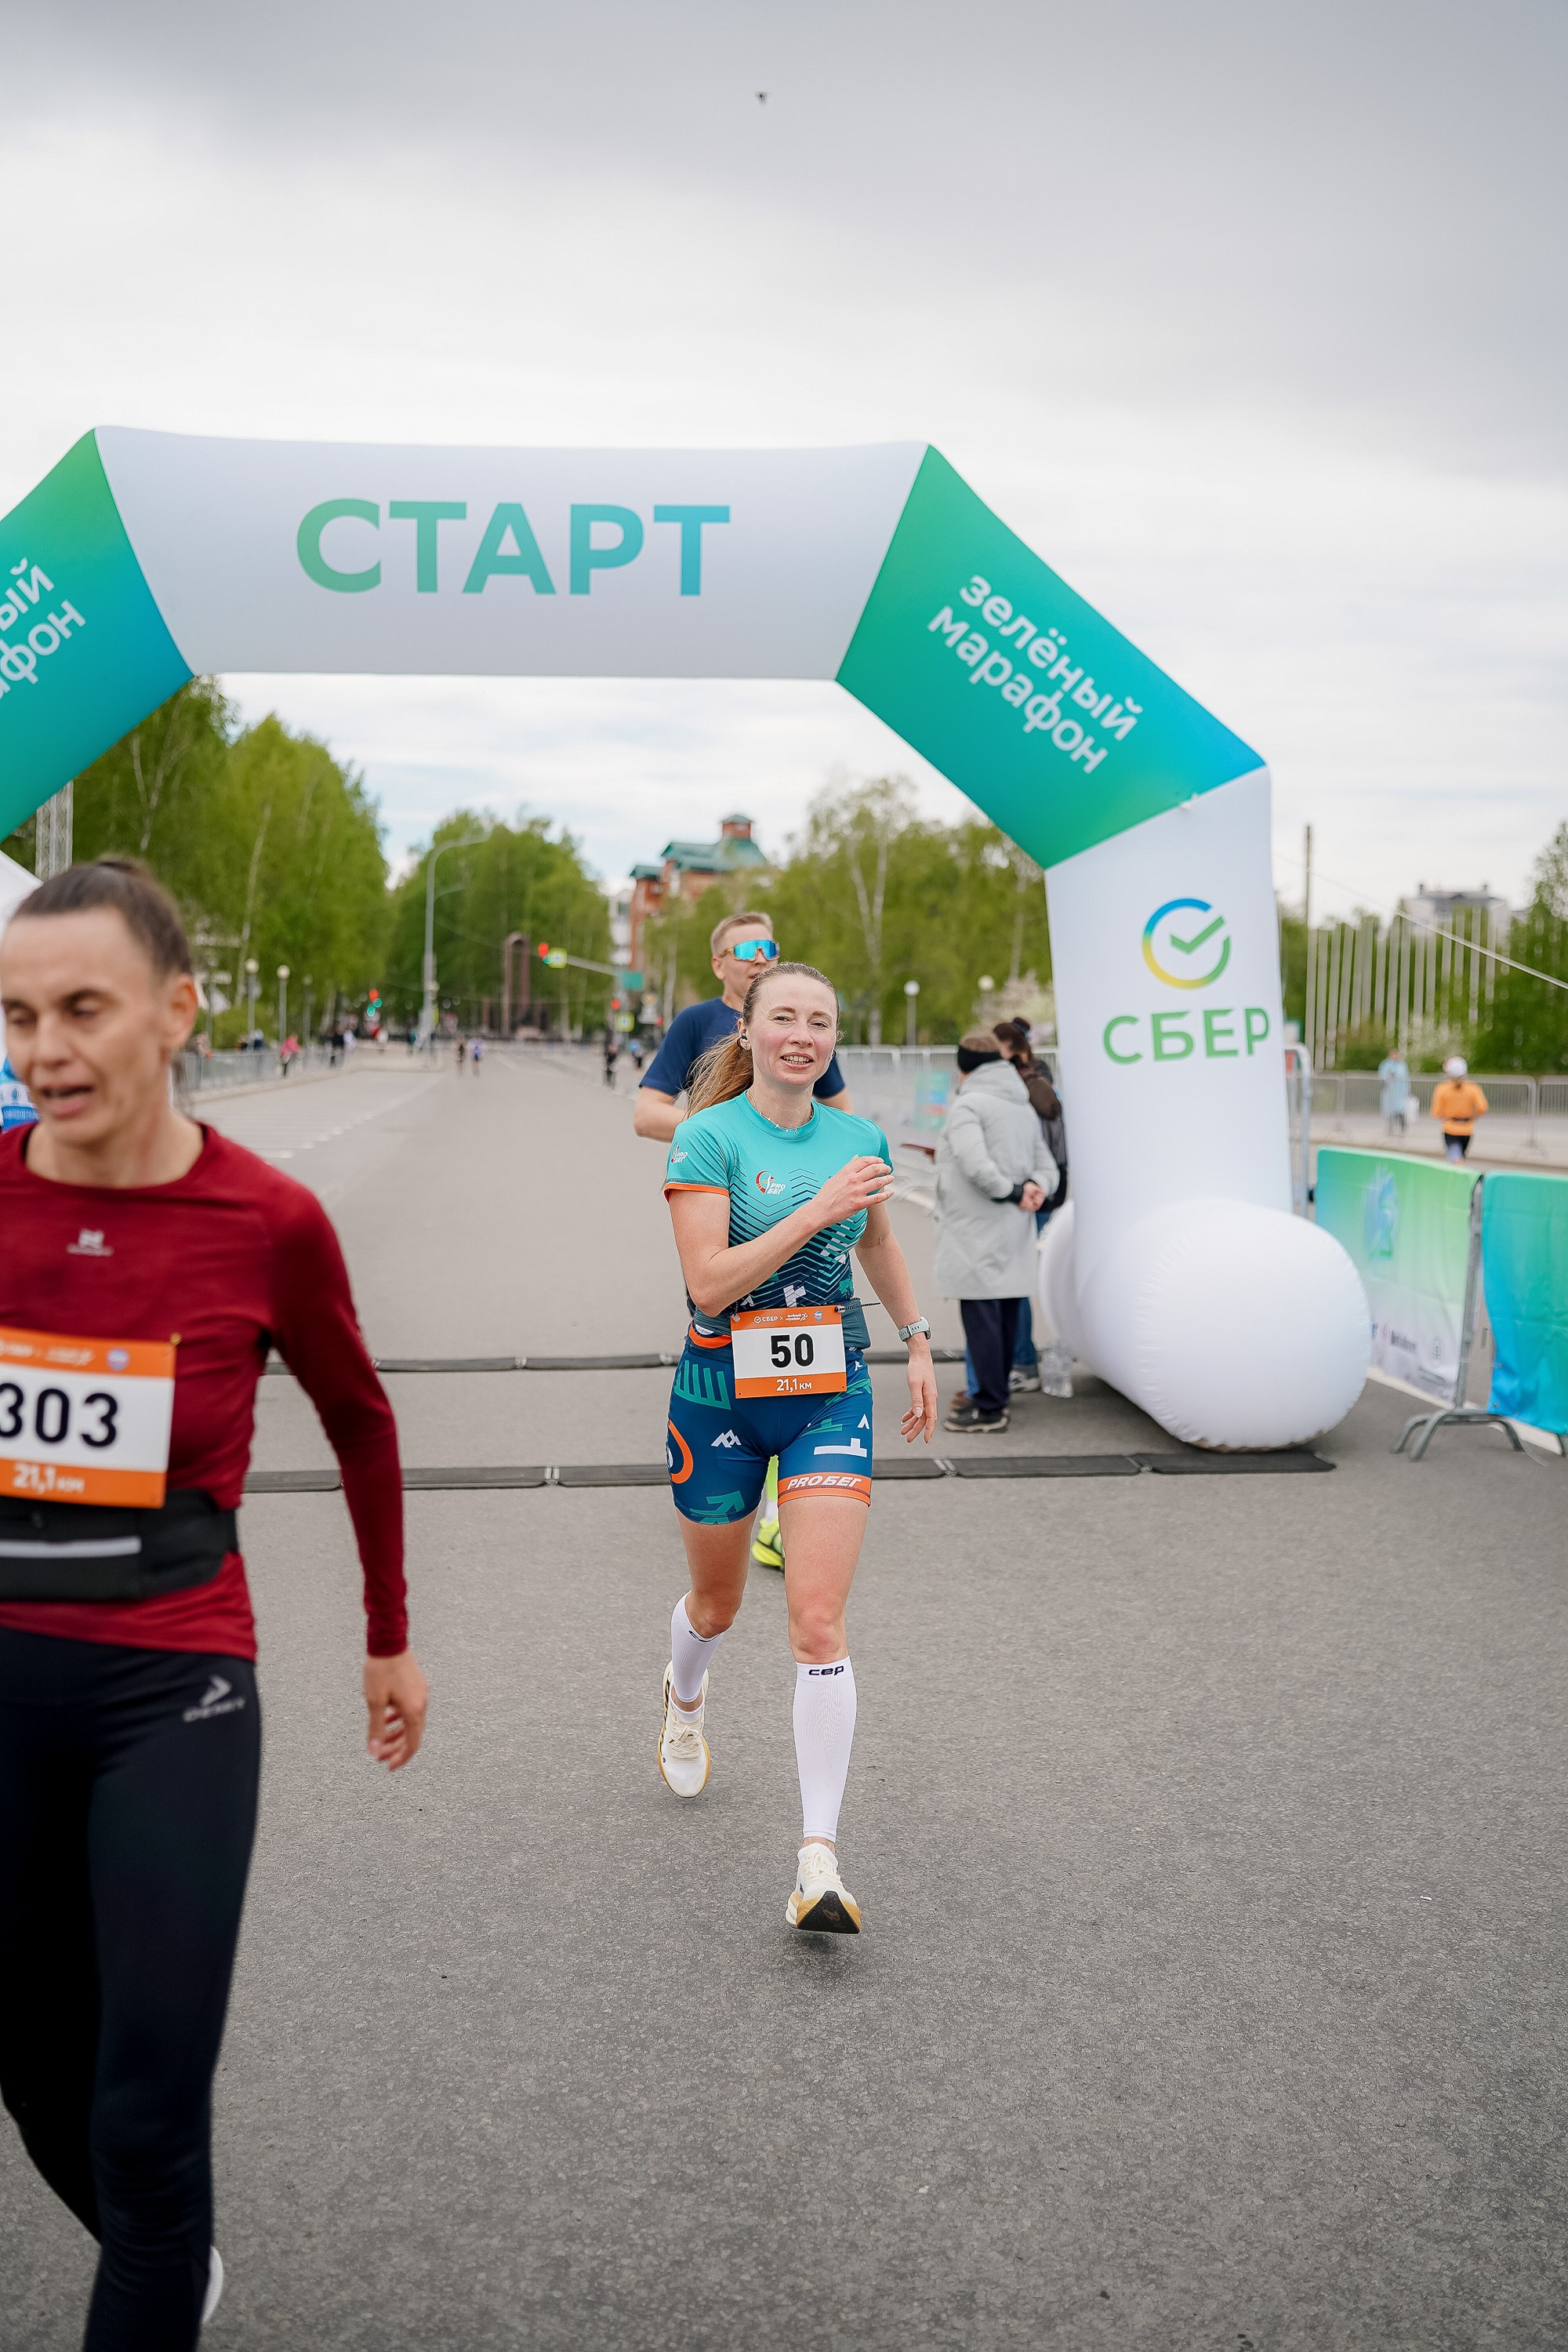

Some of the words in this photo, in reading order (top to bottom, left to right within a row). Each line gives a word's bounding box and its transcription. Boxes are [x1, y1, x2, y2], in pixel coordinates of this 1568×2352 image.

[296, 498, 731, 597] СТАРТ
[960, 575, 1143, 741] зелёный
[927, 606, 1109, 774] марафон
[1103, 1007, 1271, 1065] СБЕР
[771, 1334, 814, 1368] 50
[0, 1383, 118, 1447] 303
[776, 1377, 798, 1392] 21,1
[799, 1381, 812, 1390] км
[808, 1665, 844, 1675] cep
